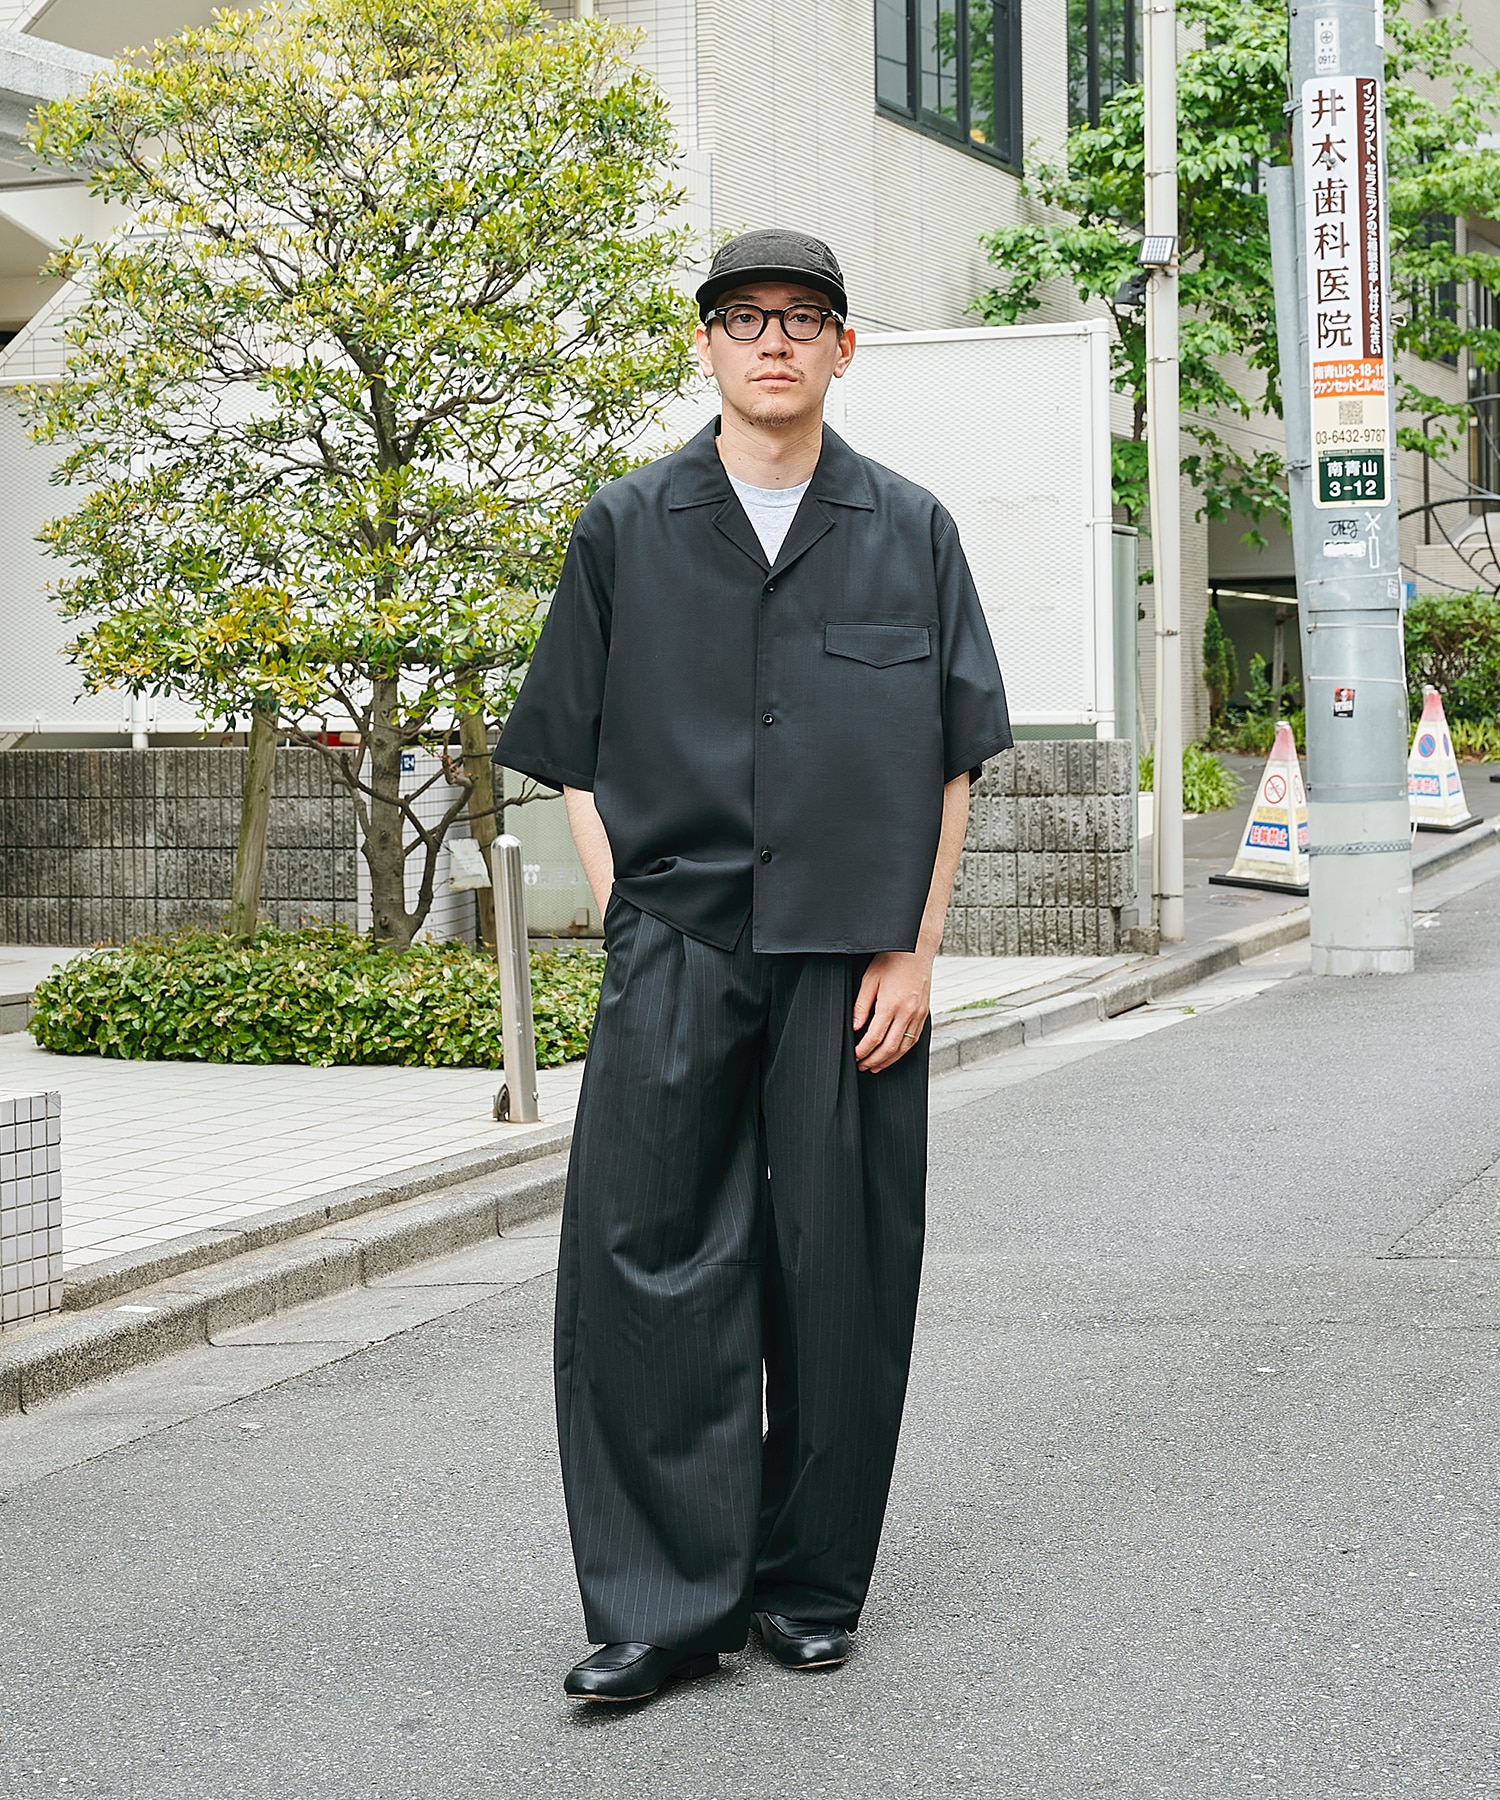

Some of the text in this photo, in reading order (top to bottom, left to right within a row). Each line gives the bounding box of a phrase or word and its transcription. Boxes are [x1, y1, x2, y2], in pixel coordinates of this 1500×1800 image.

[1318, 54, 1337, 65] 0912
[1314, 363, 1384, 380] 南青山3-18-11
[1315, 428, 1386, 445] 03-6432-9787
[1326, 459, 1378, 478] 南青山
[1328, 479, 1377, 497] 3-12
